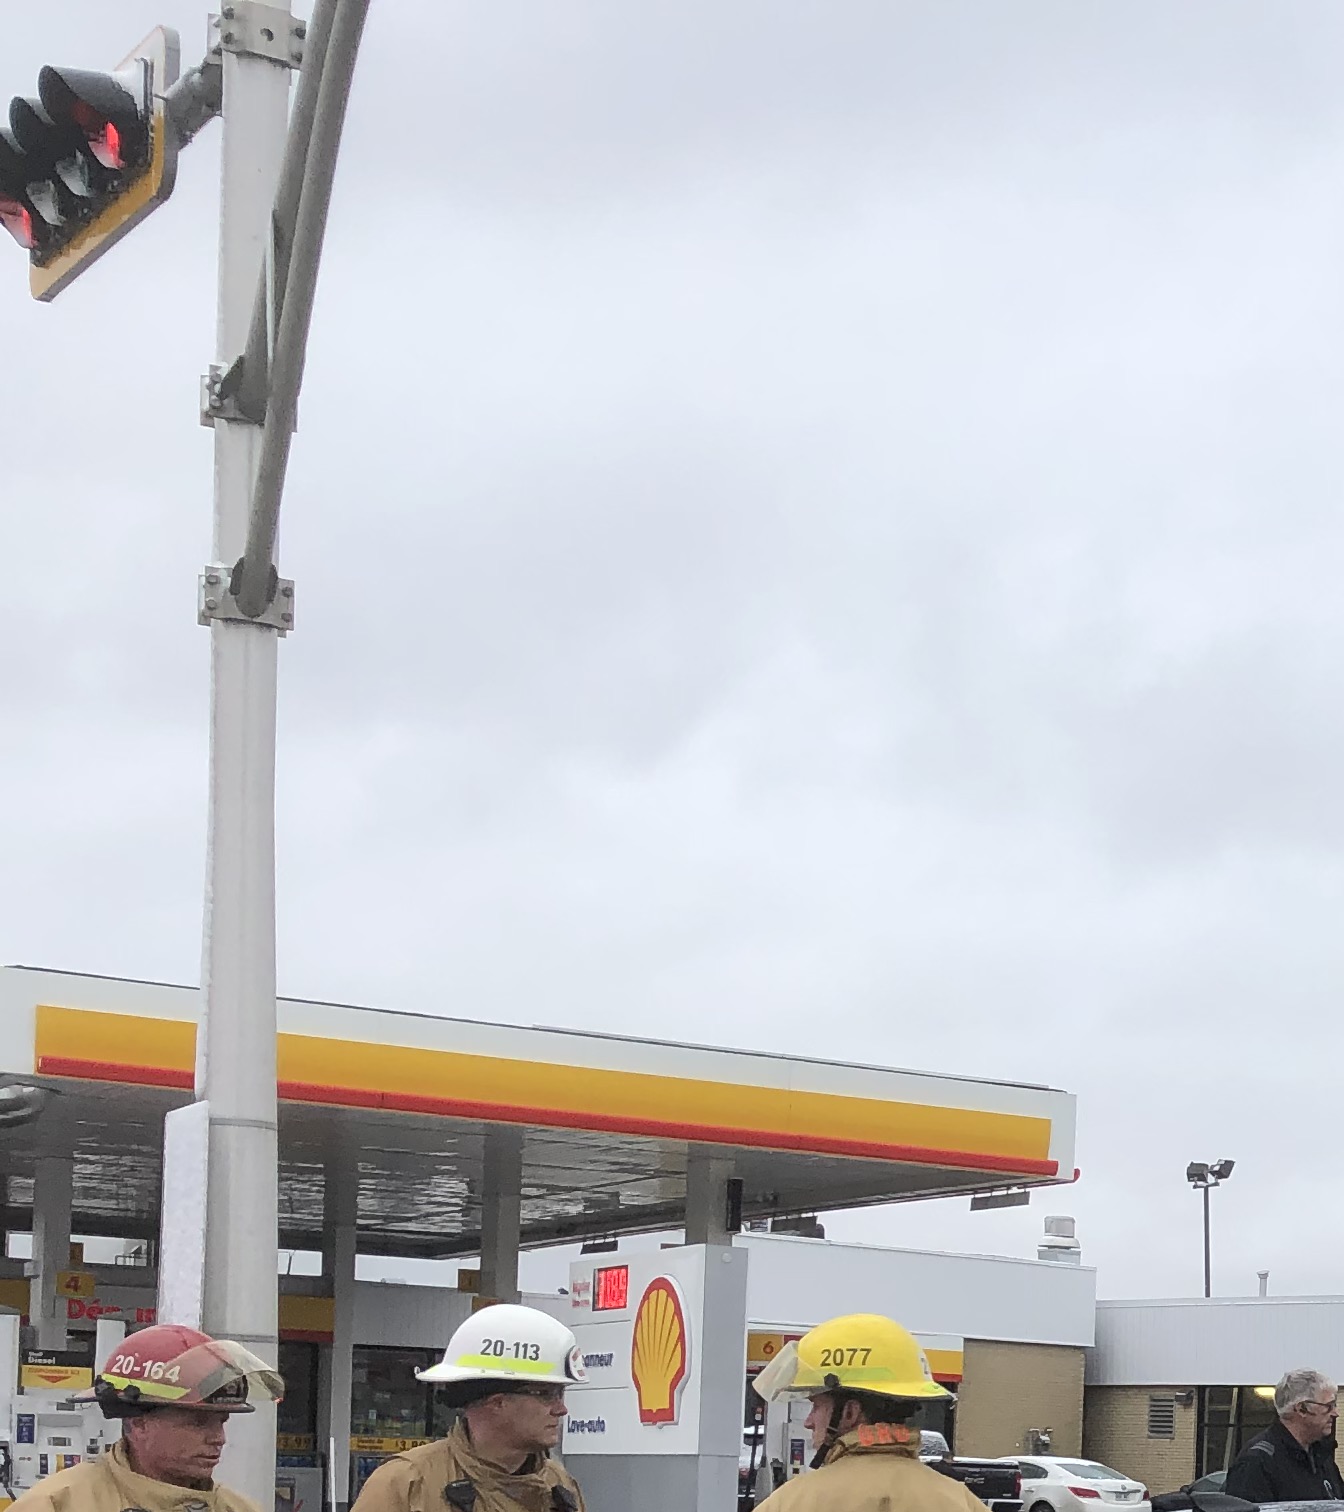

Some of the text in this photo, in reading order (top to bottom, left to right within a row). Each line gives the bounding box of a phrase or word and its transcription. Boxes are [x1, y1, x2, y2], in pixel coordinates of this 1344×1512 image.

[64, 1276, 81, 1293] 4
[480, 1338, 540, 1362] 20-113
[763, 1341, 774, 1354] 6
[820, 1348, 872, 1367] 2077
[111, 1354, 181, 1383] 20-164
[567, 1414, 606, 1434] Lave-auto
